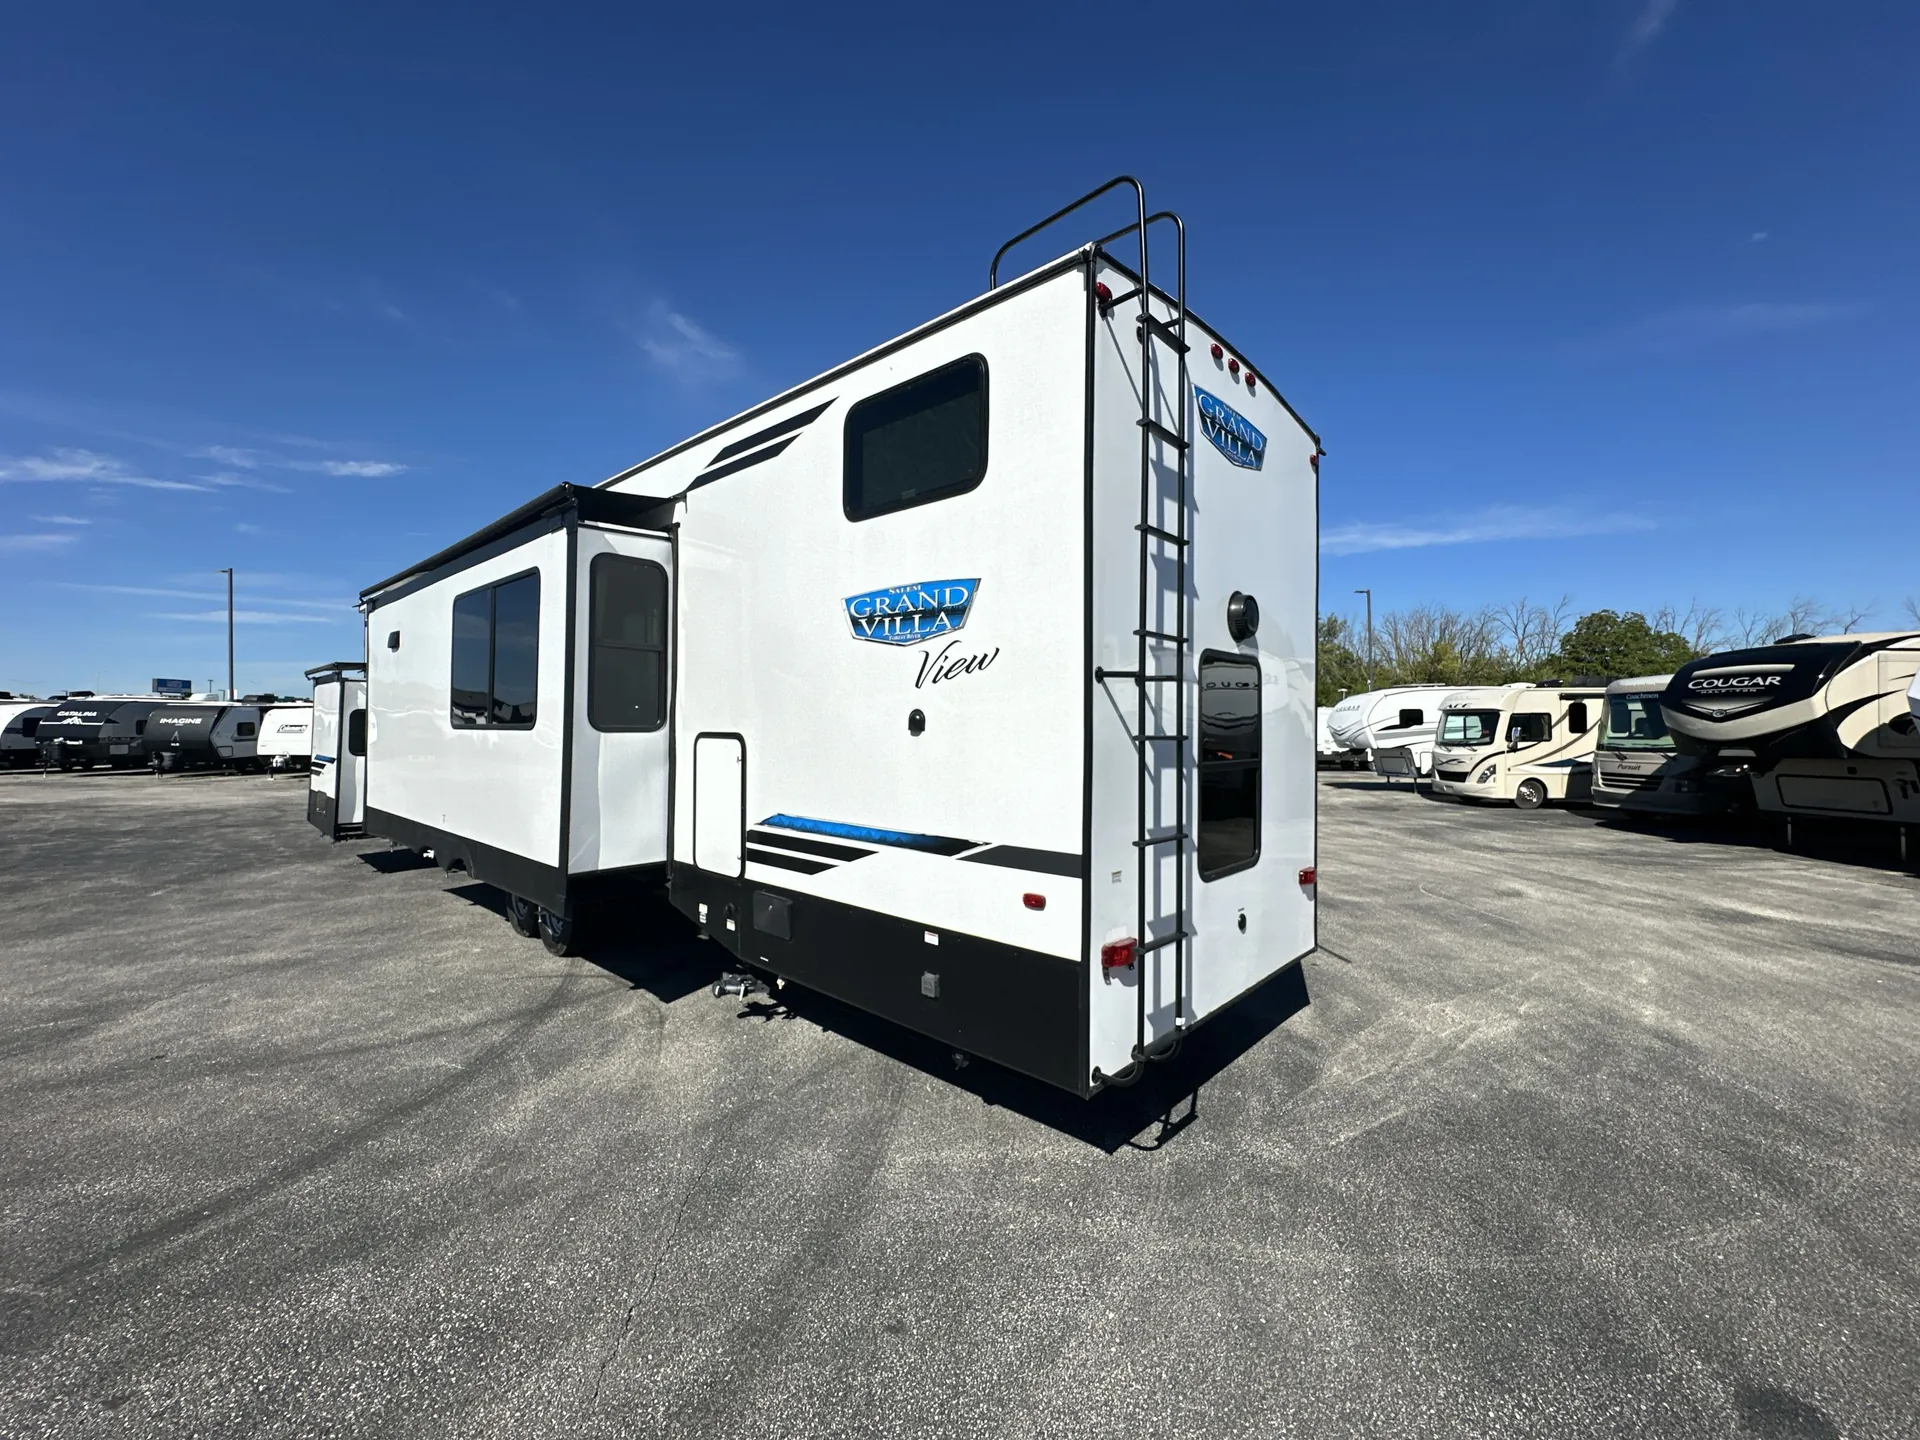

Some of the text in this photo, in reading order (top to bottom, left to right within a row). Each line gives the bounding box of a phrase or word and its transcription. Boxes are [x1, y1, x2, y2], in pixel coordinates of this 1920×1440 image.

[1198, 394, 1263, 451] GRAND
[1204, 416, 1256, 467] VILLA
[889, 585, 921, 594] SALEM
[850, 586, 969, 618] GRAND
[858, 611, 952, 637] VILLA
[914, 640, 1000, 689] View
[1687, 676, 1782, 690] COUGAR
[1626, 692, 1659, 700] Coachmen
[159, 717, 203, 725] IMAGINE
[1617, 763, 1642, 771] Pursuit
